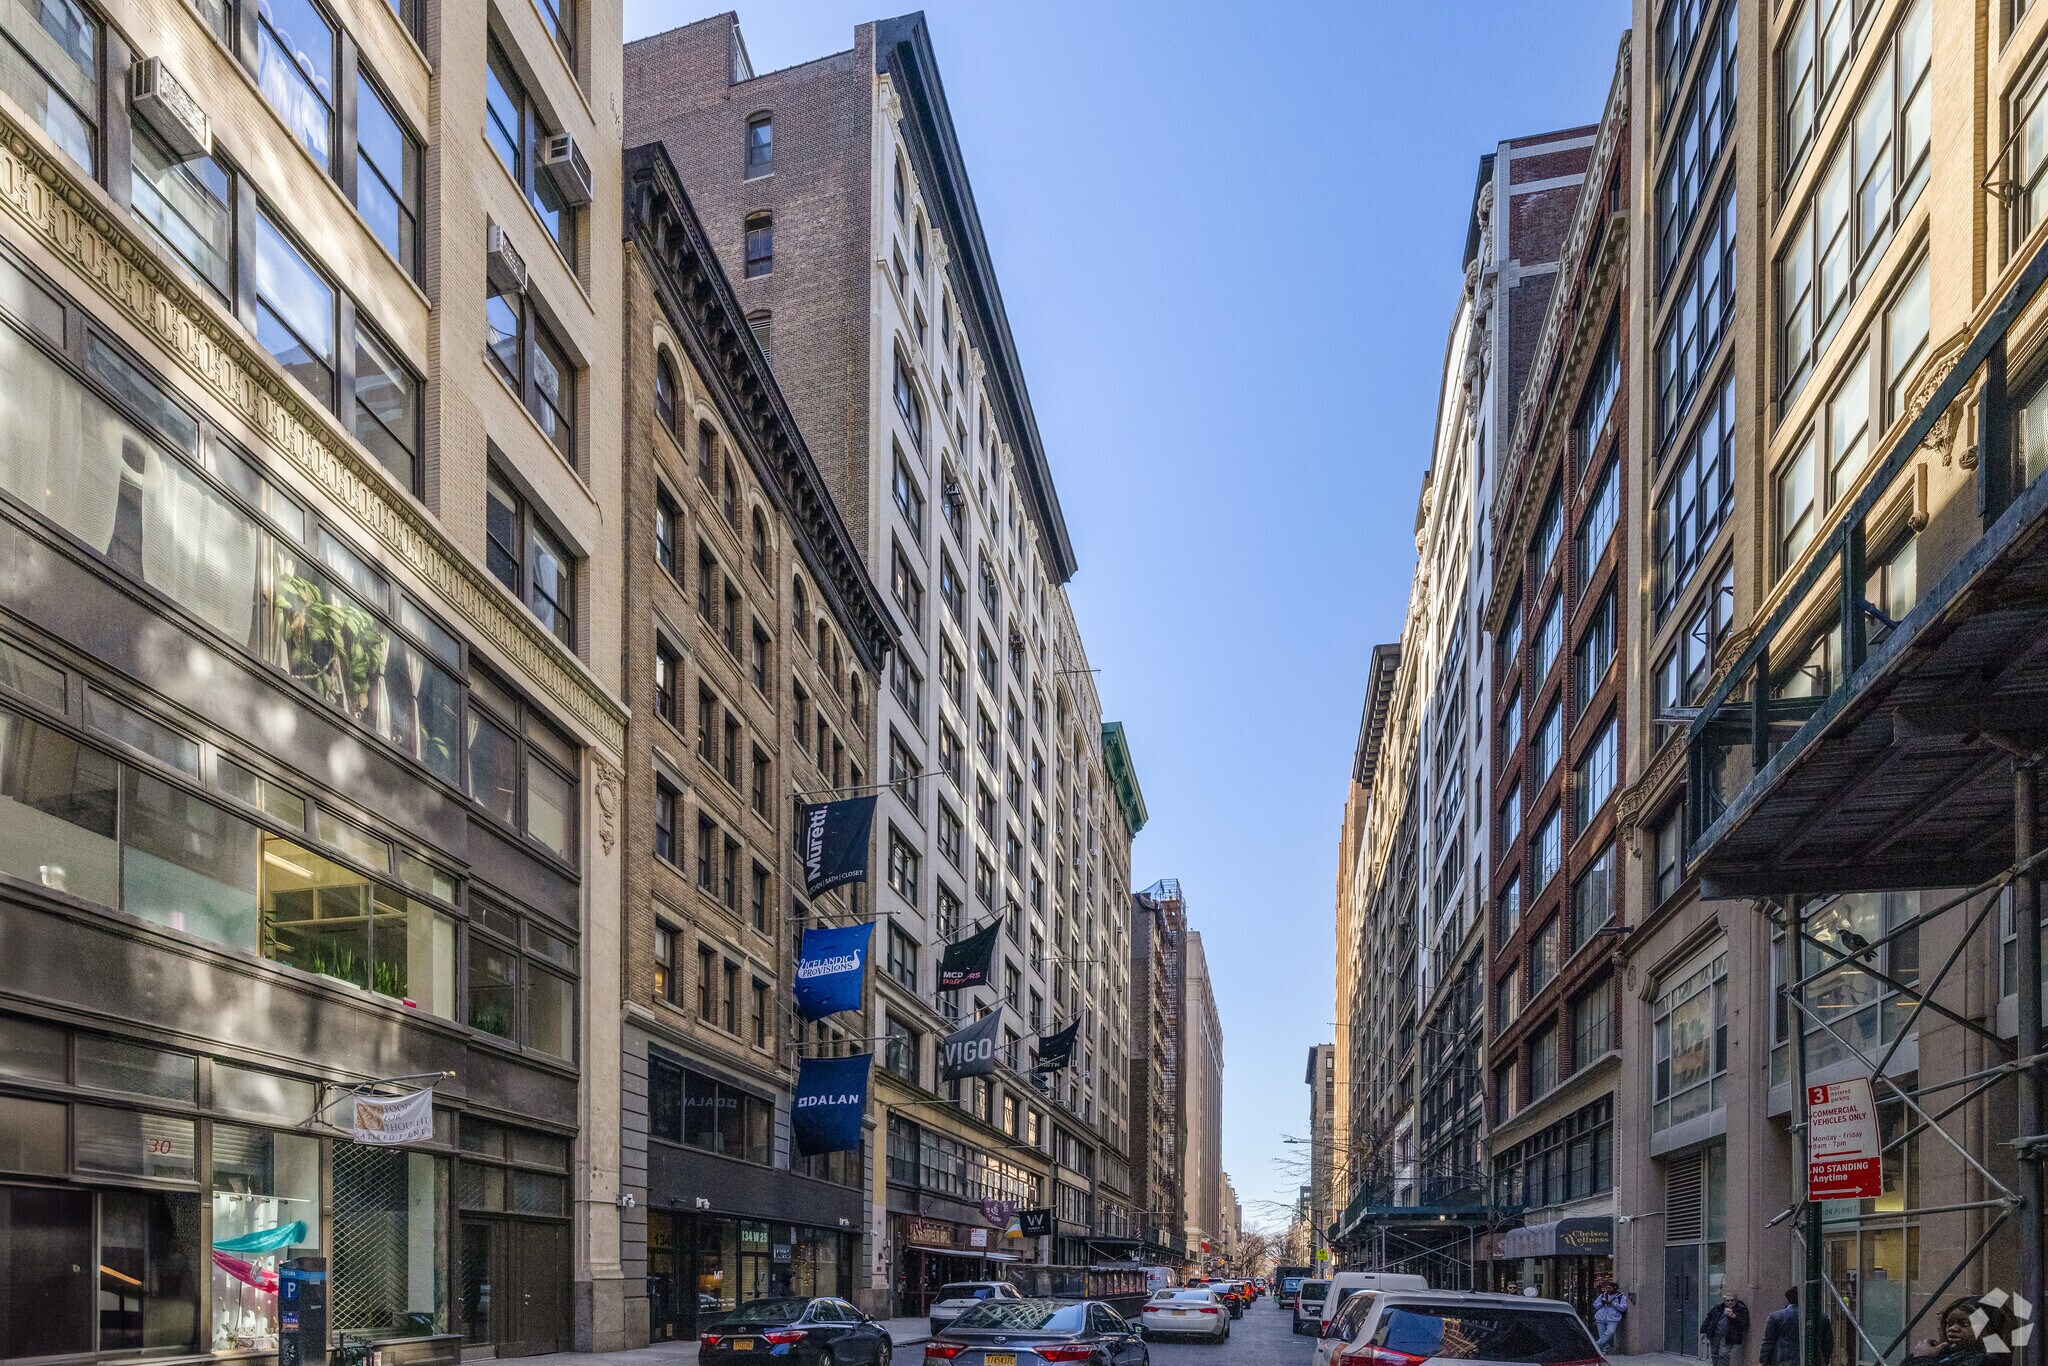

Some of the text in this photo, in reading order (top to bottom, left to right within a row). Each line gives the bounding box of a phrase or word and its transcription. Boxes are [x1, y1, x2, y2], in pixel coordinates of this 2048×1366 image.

[825, 875, 838, 885] BATH
[841, 869, 863, 879] CLOSET
[805, 955, 852, 969] ICELANDIC
[803, 962, 853, 977] PROVISIONS
[1813, 1088, 1824, 1103] 3
[384, 1113, 401, 1121] FOR
[1813, 1105, 1858, 1118] COMMERCIAL
[385, 1117, 429, 1131] THOUHT
[1813, 1112, 1866, 1126] VEHICLES ONLY
[1813, 1134, 1837, 1142] Monday
[1826, 1162, 1869, 1173] STANDING
[1813, 1174, 1848, 1183] Anytime
[741, 1230, 768, 1243] 134 W 25
[1560, 1233, 1609, 1247] Wellness
[1572, 1230, 1609, 1238] Chelsea
[287, 1282, 297, 1298] P
